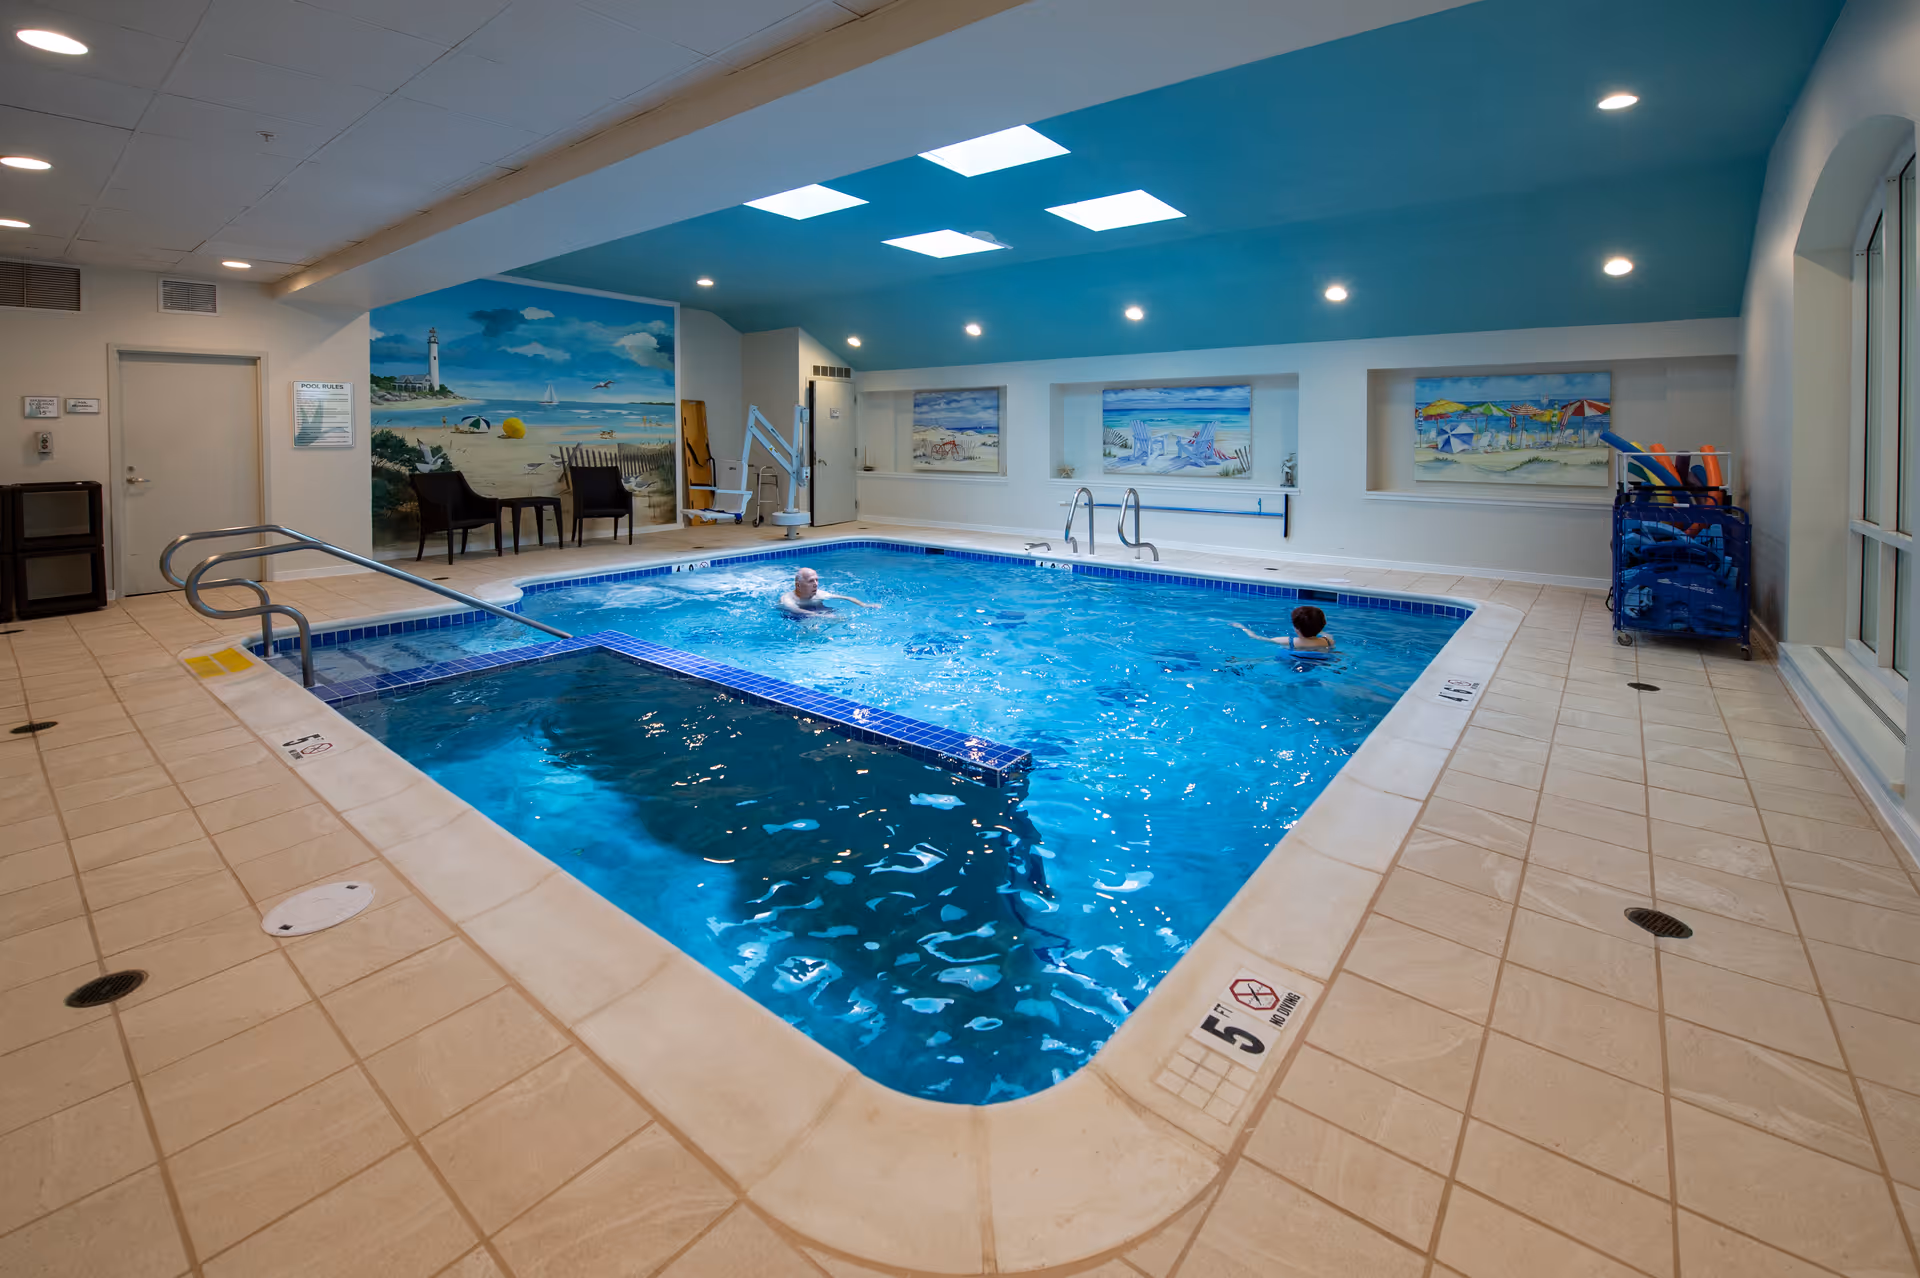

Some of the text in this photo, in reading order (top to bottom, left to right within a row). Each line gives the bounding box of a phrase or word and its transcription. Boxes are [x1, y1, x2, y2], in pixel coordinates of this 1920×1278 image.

[282, 733, 321, 747] 5
[1269, 991, 1301, 1028] NO DIVING
[1200, 1014, 1265, 1054] 5
